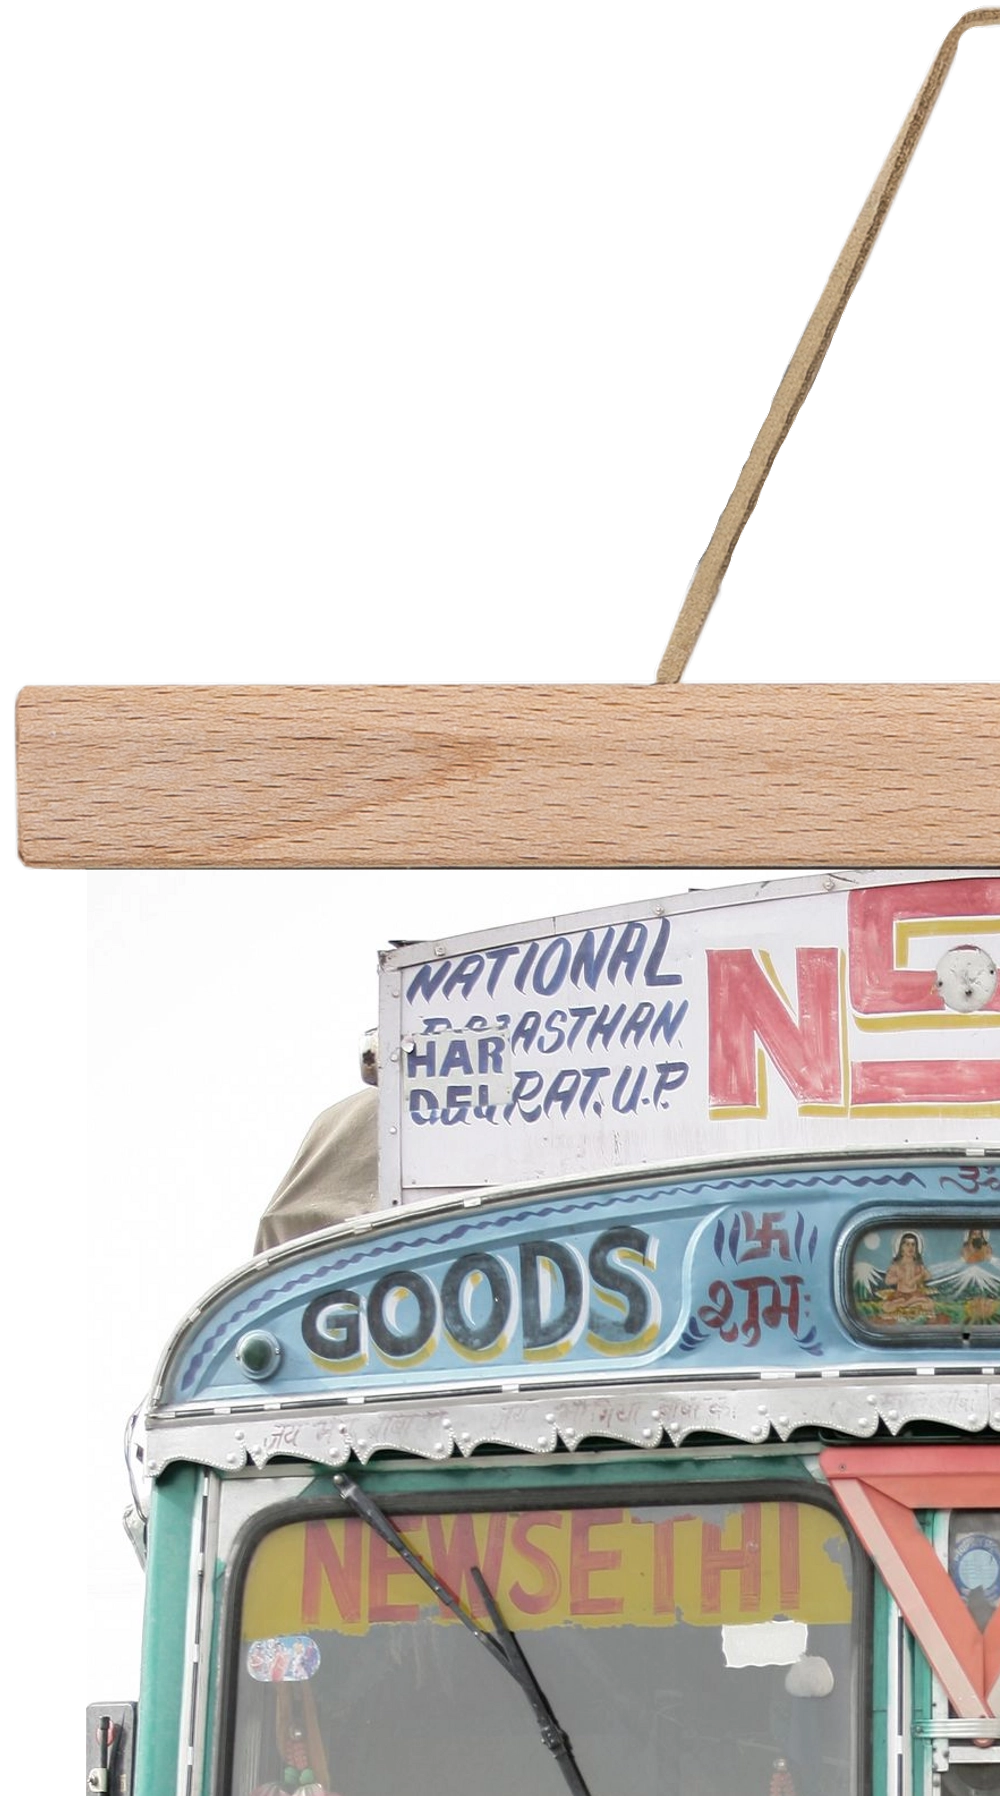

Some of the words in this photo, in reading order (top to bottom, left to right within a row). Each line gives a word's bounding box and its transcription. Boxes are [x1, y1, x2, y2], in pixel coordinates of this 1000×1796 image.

[406, 918, 683, 1004] NATIONAL
[406, 1035, 504, 1079] HAR
[301, 1226, 660, 1374] GOODS
